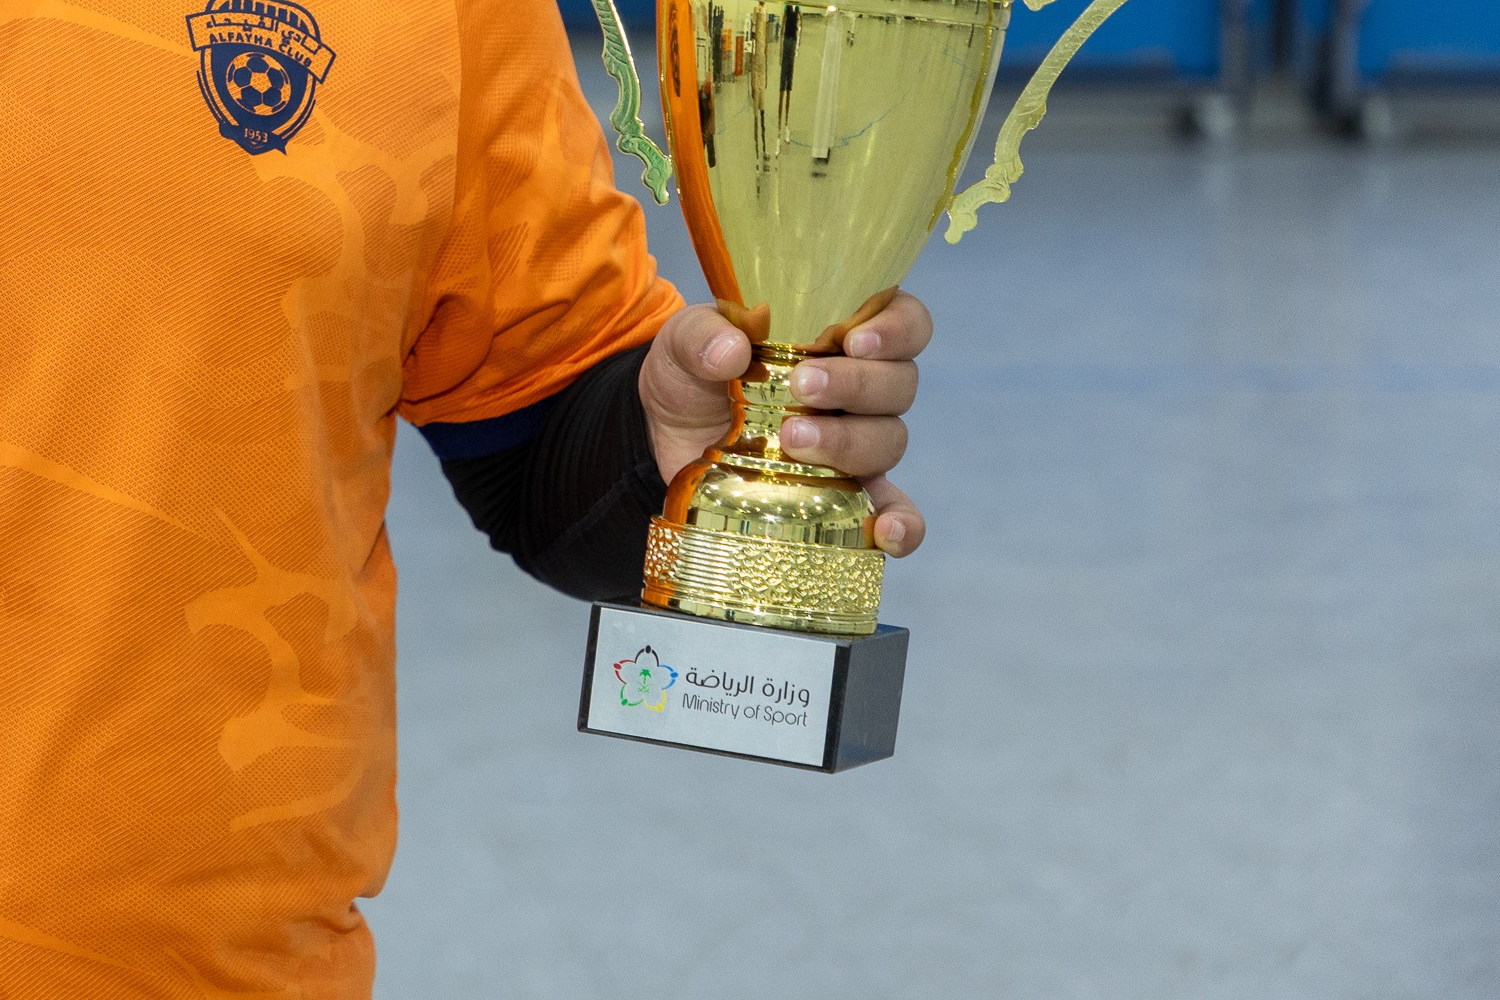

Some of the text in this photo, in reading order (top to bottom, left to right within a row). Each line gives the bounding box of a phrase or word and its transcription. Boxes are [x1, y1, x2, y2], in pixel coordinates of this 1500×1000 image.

[209, 32, 312, 67] ALFAYHA CLUB
[244, 127, 268, 142] 1953
[685, 667, 810, 707] وزارة الرياضة
[682, 693, 808, 727] Ministry of Sport
